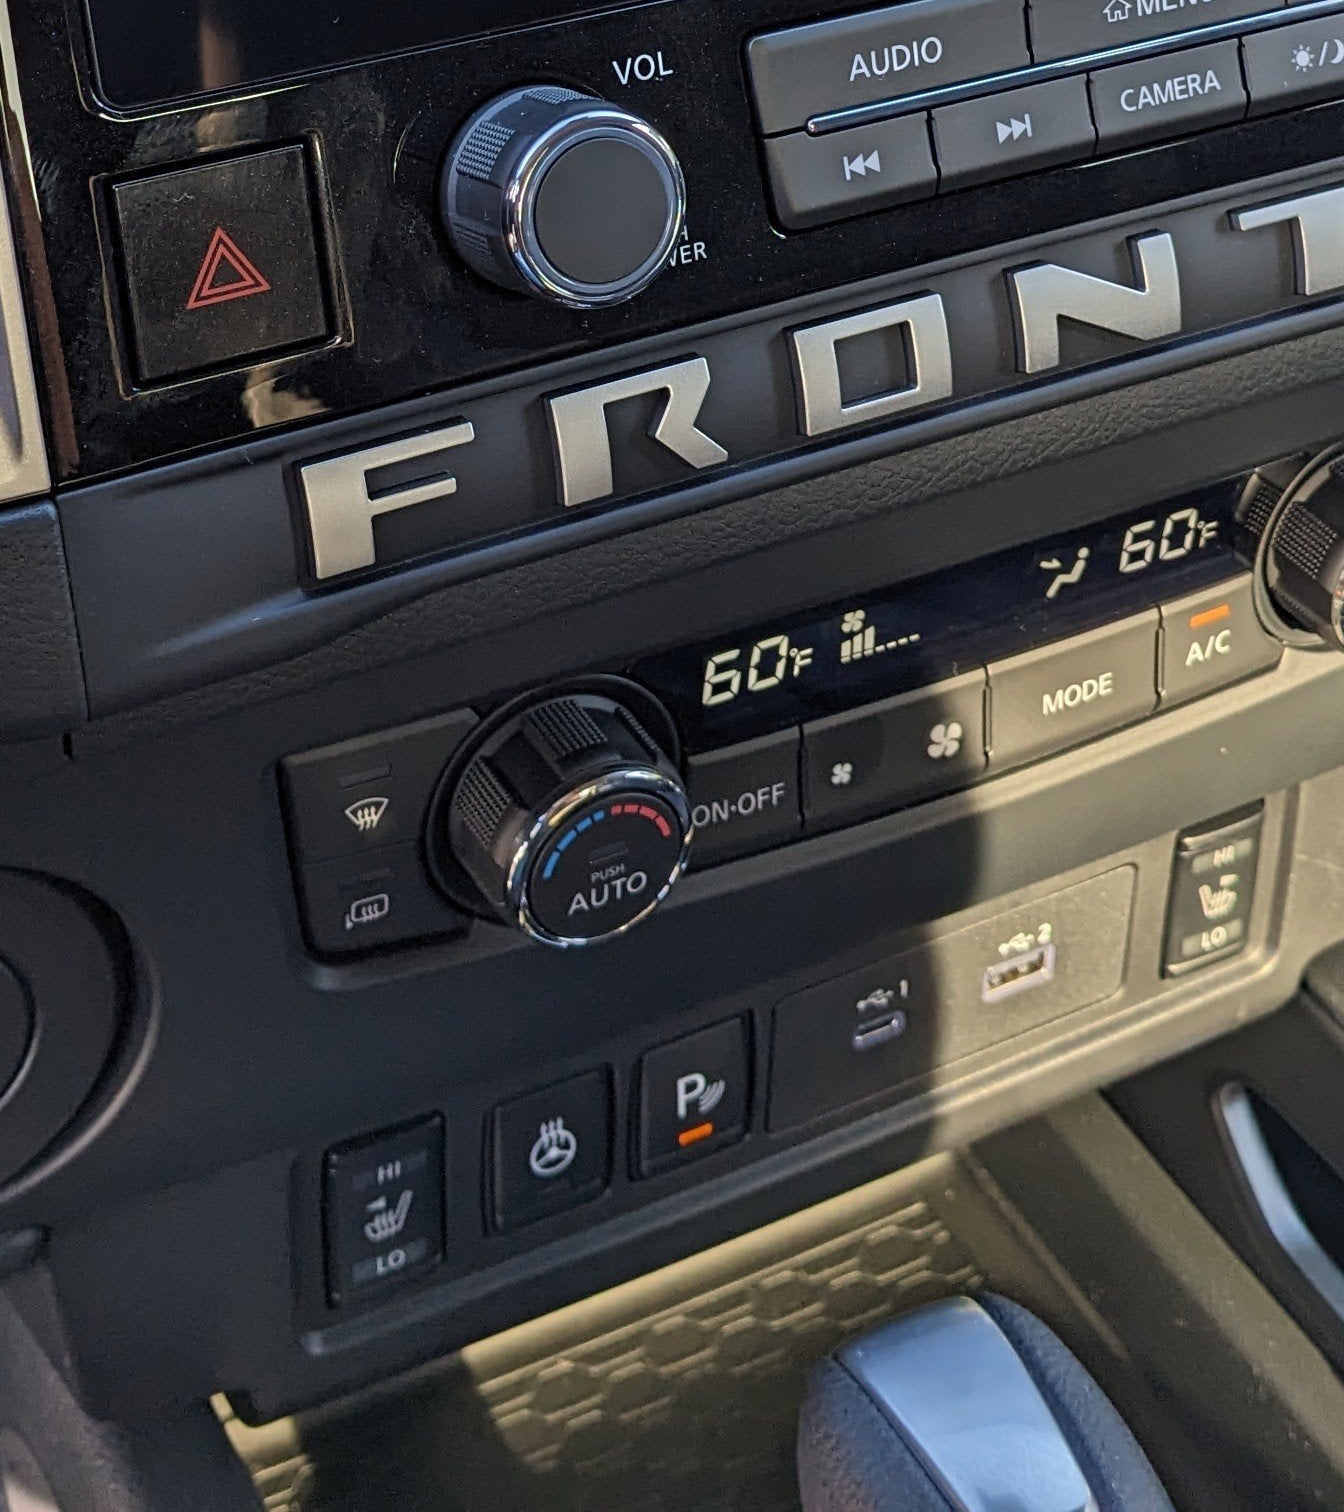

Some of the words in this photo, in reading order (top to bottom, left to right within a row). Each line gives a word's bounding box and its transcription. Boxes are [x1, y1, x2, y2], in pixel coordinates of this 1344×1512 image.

[612, 51, 674, 86] VOL
[848, 36, 944, 81] AUDIO
[1120, 68, 1222, 113] CAMERA
[1185, 629, 1232, 667] A/C
[1041, 671, 1113, 716] MODE
[568, 870, 648, 916] AUTO
[1201, 925, 1227, 951] LO
[676, 1072, 706, 1119] P
[376, 1248, 406, 1276] LO
